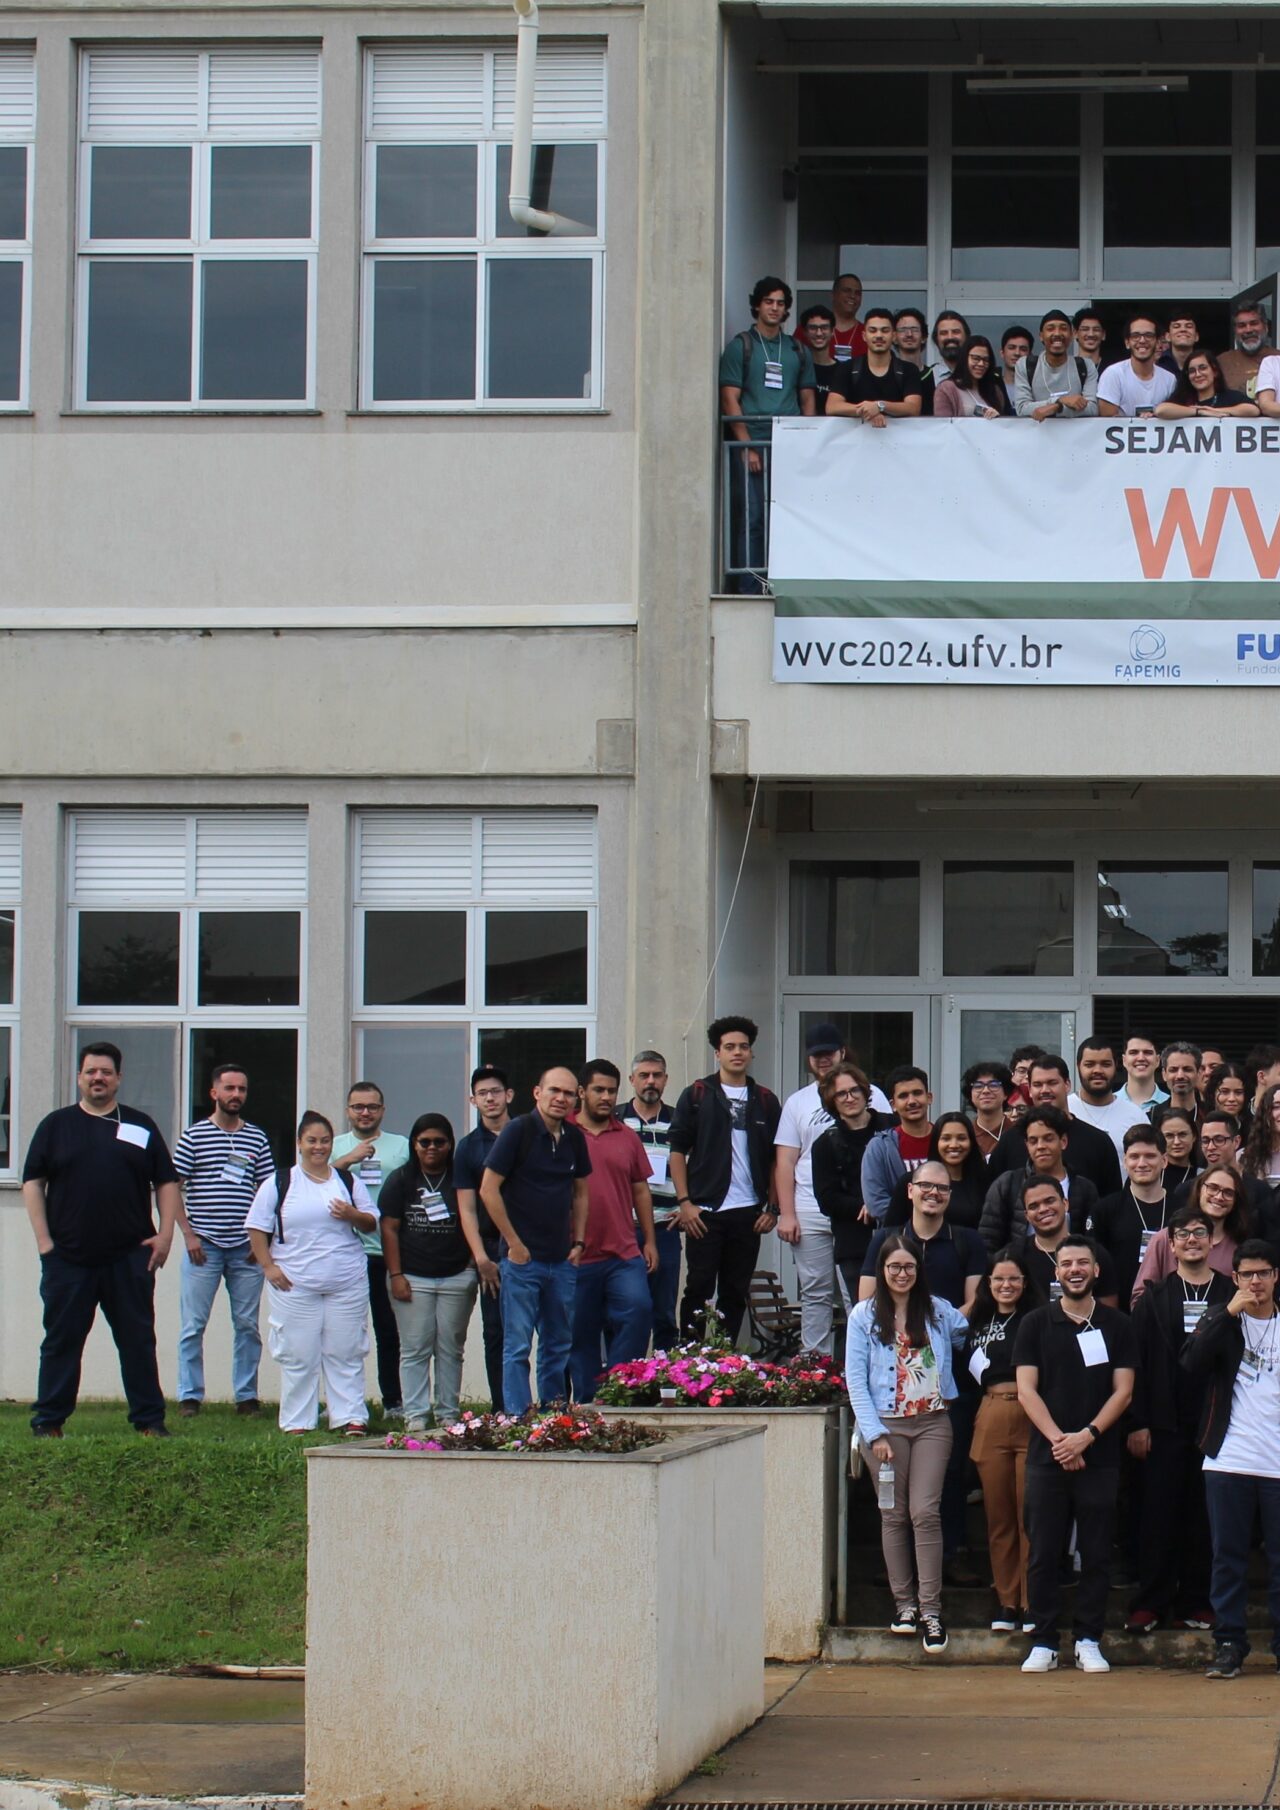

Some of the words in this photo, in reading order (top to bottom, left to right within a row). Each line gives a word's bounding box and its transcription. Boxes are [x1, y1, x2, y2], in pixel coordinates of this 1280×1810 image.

[1105, 426, 1221, 454] SEJAM
[781, 634, 1063, 669] wvc2024.ufv.br
[1115, 664, 1181, 678] FAPEMIG
